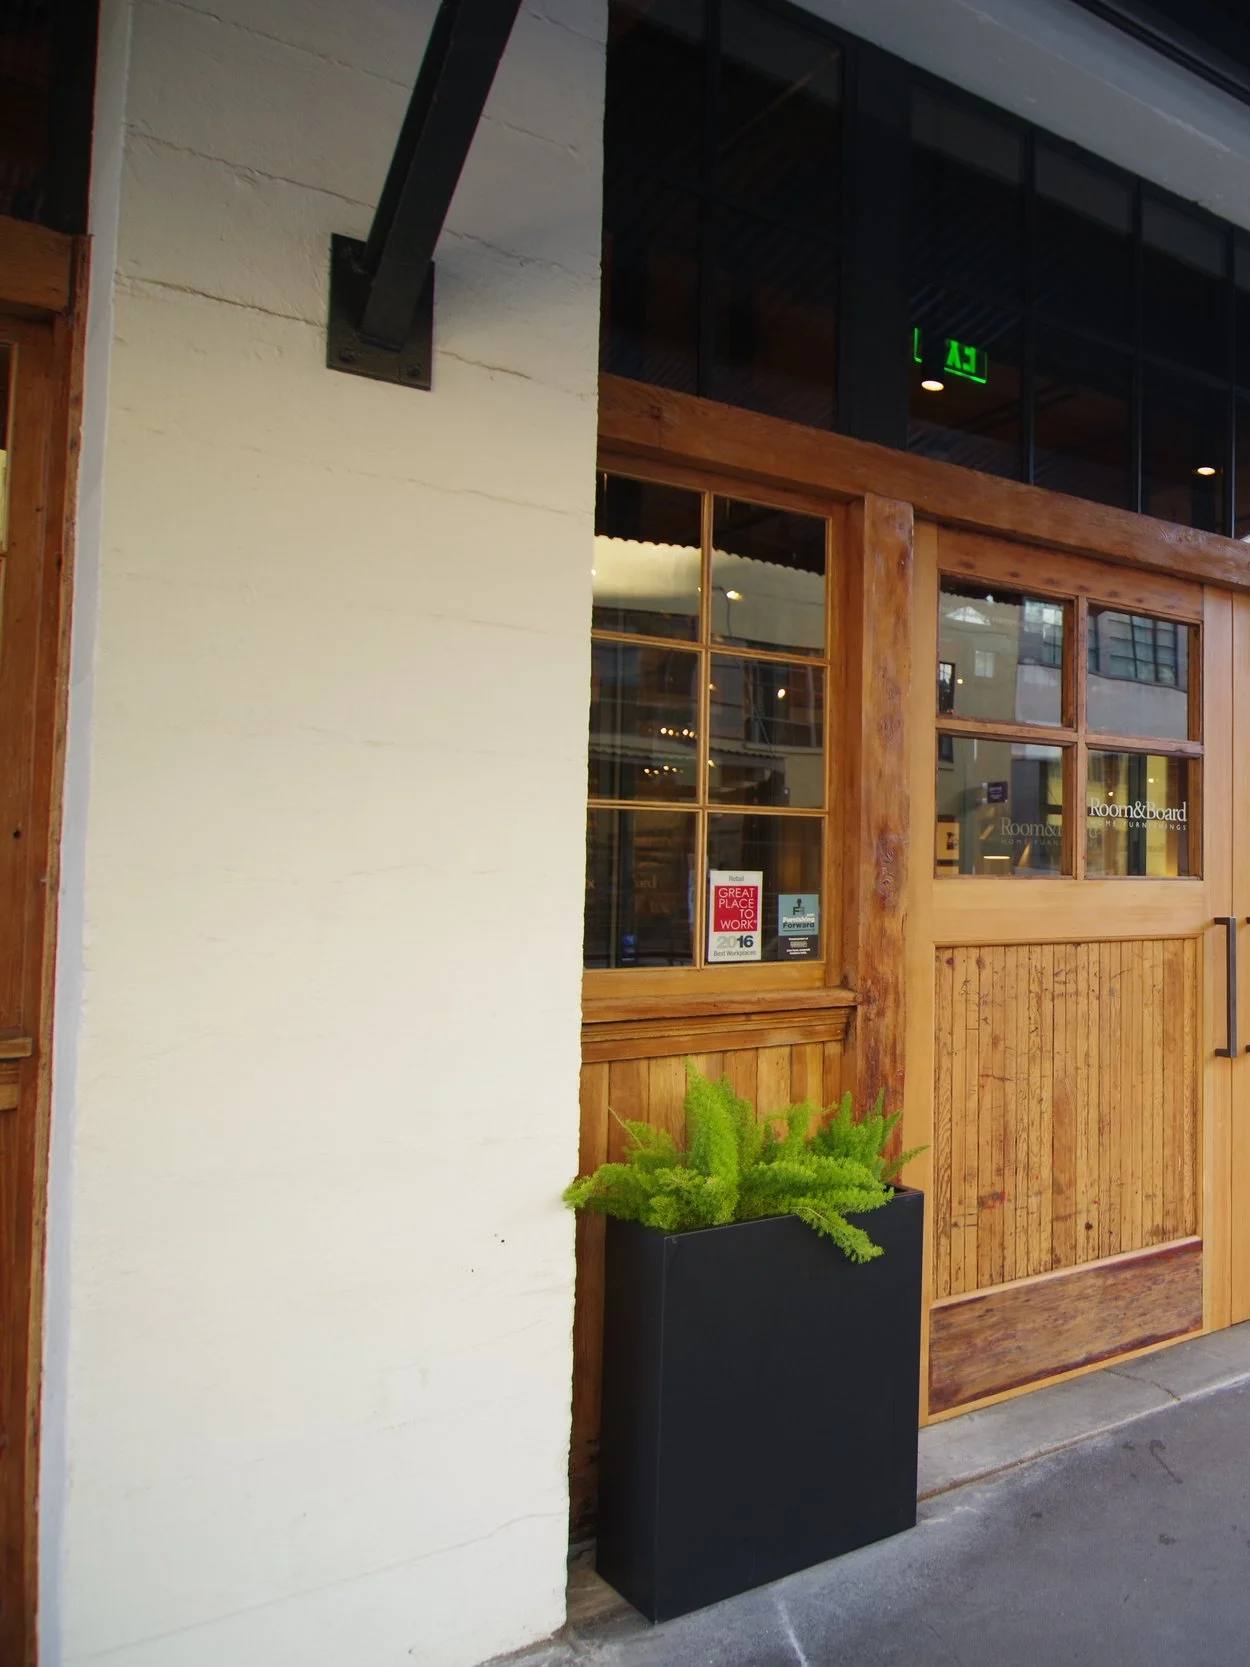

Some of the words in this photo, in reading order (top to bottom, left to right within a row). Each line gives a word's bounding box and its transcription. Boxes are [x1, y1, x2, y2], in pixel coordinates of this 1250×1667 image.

[1089, 797, 1187, 822] Room&Board
[718, 888, 755, 898] GREAT
[718, 899, 754, 909] PLACE
[740, 909, 754, 919] TO
[782, 916, 816, 924] Furnishing
[717, 934, 754, 949] 2016
